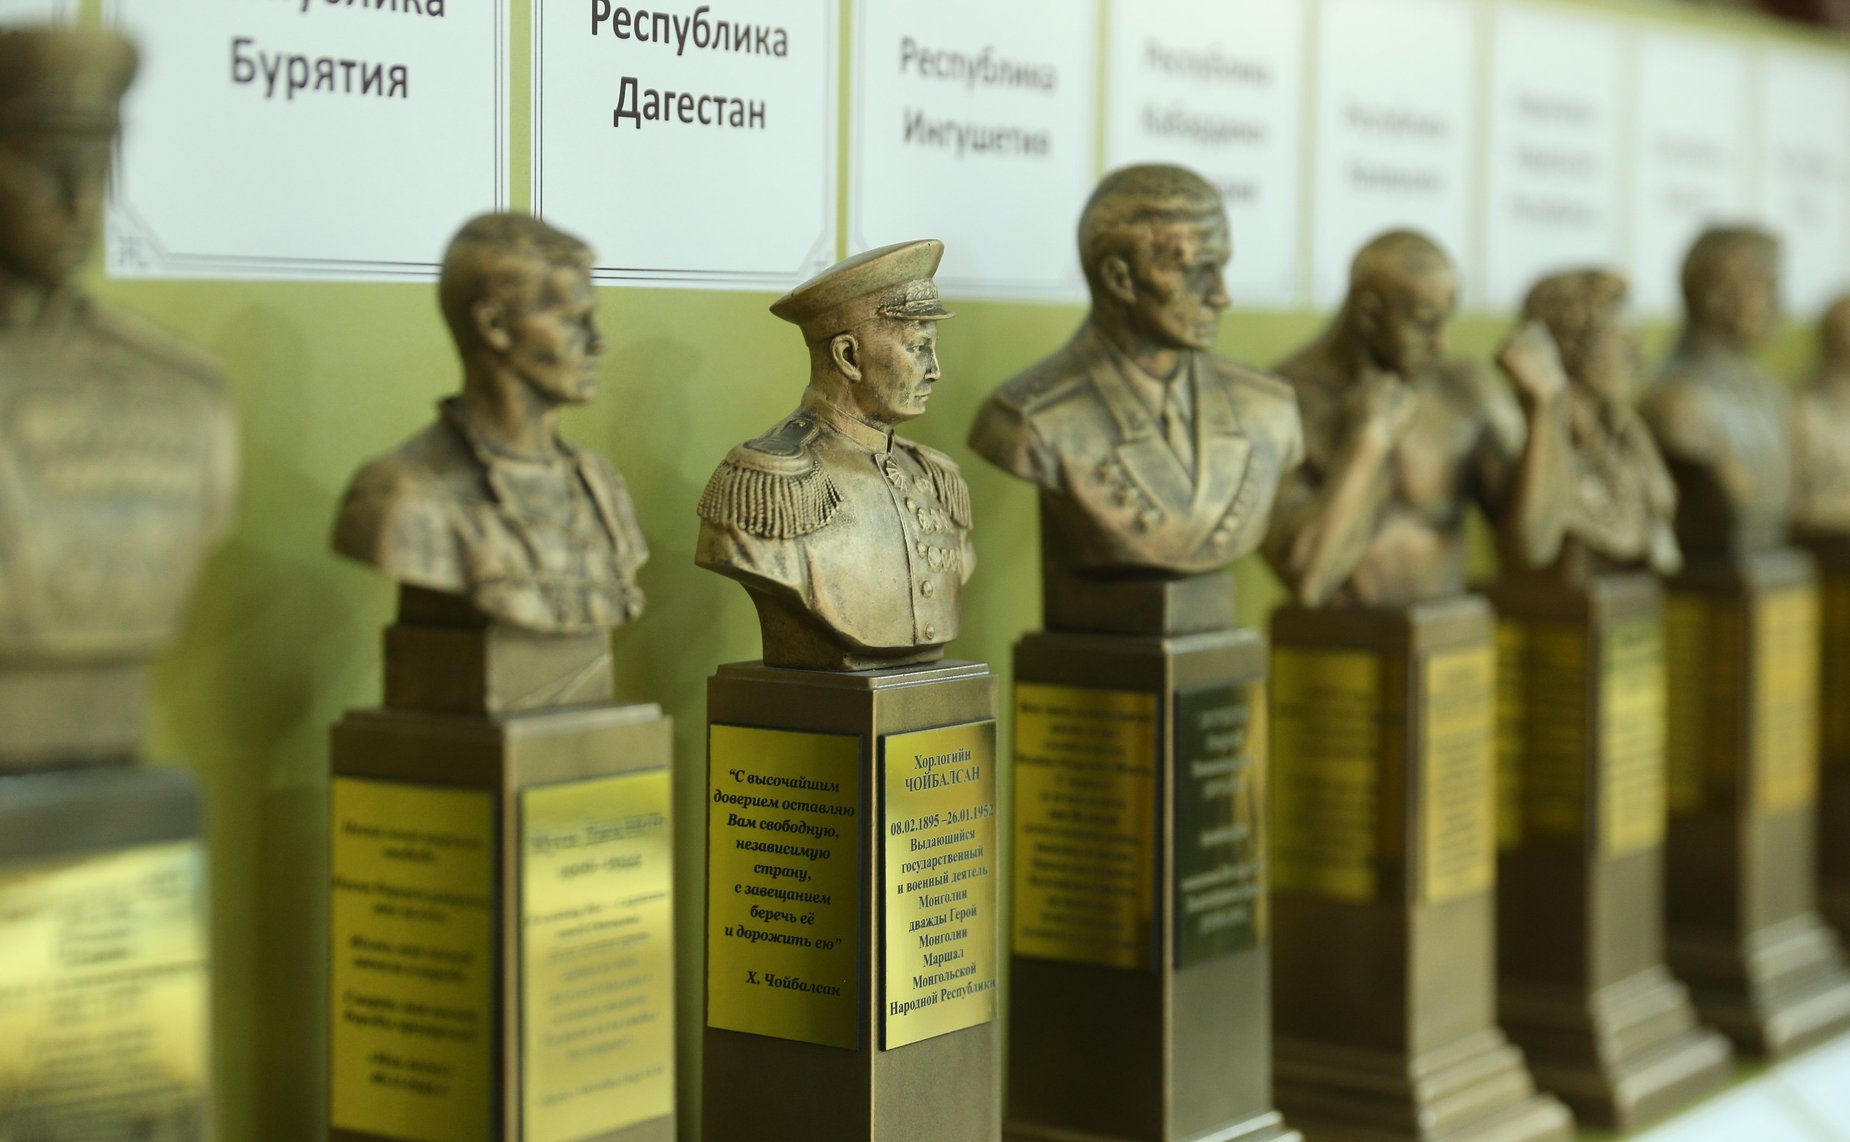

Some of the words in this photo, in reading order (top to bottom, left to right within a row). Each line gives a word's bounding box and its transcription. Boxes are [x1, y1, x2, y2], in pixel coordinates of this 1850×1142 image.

[591, 0, 788, 57] Республика
[231, 37, 409, 100] Бурятия
[899, 35, 1058, 92] Республика
[613, 76, 766, 130] Дагестан
[902, 106, 1051, 158] Ингушетия
[914, 748, 971, 771] Хорлогийн
[747, 774, 840, 793] высочайшим
[905, 766, 980, 792] ЧОЙБАЛСАН
[713, 789, 779, 809] доверием
[782, 799, 856, 817] оставляю
[727, 813, 757, 829] Вам
[760, 820, 840, 840] свободную,
[890, 814, 940, 836] 08.02.1895
[736, 839, 831, 861] независимую
[910, 828, 976, 852] Выдающийся
[901, 845, 985, 874] государственный
[754, 864, 812, 882] страну,
[897, 884, 904, 894] и
[906, 871, 949, 893] военный
[951, 866, 988, 883] деятель
[734, 884, 742, 894] с
[744, 885, 832, 905] завещанием
[919, 889, 968, 909] Монголии
[750, 905, 797, 923] беречь
[800, 912, 815, 925] её
[908, 914, 947, 932] дважды
[950, 904, 977, 922] Герой
[725, 926, 733, 937] и
[736, 925, 812, 949] дорожить
[919, 928, 968, 949] Монголии
[923, 948, 964, 968] Маршал
[765, 973, 841, 997] Чойбалсан
[912, 961, 977, 990] Монгольской
[889, 991, 938, 1016] Народной
[940, 978, 996, 1002] Республики
